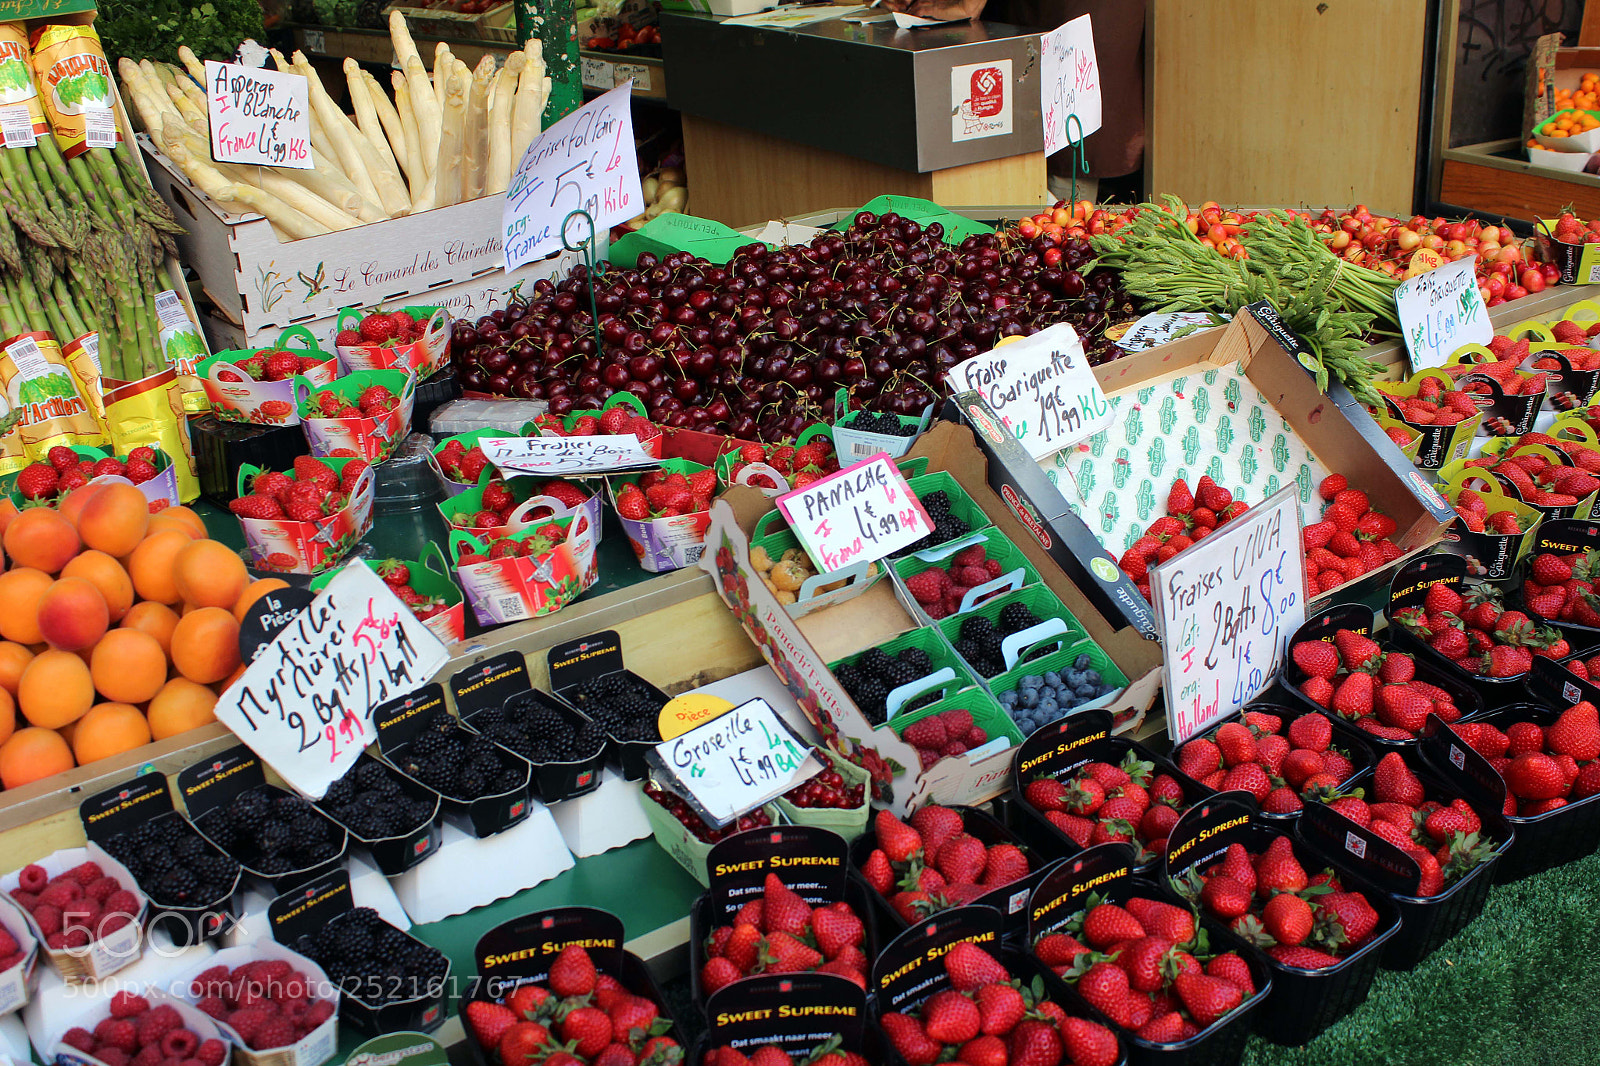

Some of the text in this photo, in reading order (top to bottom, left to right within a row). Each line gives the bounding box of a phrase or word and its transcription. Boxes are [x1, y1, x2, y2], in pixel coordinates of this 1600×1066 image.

[215, 65, 275, 108] Asperge
[243, 92, 301, 122] Blanche
[218, 122, 256, 157] France
[604, 176, 629, 217] Kilo
[505, 225, 550, 268] France
[1420, 252, 1438, 268] 1kg
[333, 236, 503, 294] Le Canard des Clairettes
[965, 359, 1007, 390] Fraise
[990, 350, 1075, 411] Gariguette
[31, 396, 88, 423] Artillero
[1423, 427, 1441, 468] Gariguette
[803, 464, 888, 521] PANACHE
[1003, 486, 1020, 510] PRINCE
[1023, 513, 1049, 547] BRETAGNE
[1488, 536, 1509, 578] Gariguette
[1540, 539, 1579, 552] SWEET
[1169, 565, 1223, 621] Fraises
[1232, 508, 1282, 581] VIVA
[266, 596, 282, 611] la
[1391, 586, 1415, 601] SWEET
[259, 607, 299, 632] Pièce
[552, 645, 617, 670] SWEET SUPREME
[457, 666, 522, 697] SWEET SUPREME
[379, 698, 442, 730] SWEET SUPREME
[1178, 678, 1219, 742] Holland
[288, 712, 321, 753] 2
[673, 713, 753, 768] Groseille
[1020, 730, 1106, 773] SWEET SUPREME
[186, 760, 255, 796] SWEET SUPREME
[88, 787, 163, 823] SWEET SUPREME
[1169, 815, 1250, 864] SWEET SUPREME
[715, 859, 765, 877] SWEET
[770, 855, 841, 868] SUPREME
[276, 883, 347, 925] SWEET SUPREME
[728, 888, 743, 898] Dat
[1033, 867, 1128, 922] SWEET SUPREME
[484, 947, 537, 969] SWEET
[881, 957, 922, 989] SWEET
[716, 1005, 857, 1027] SWEET SUPREME
[731, 1039, 748, 1049] Dat
[749, 1034, 784, 1046] smaakt
[784, 1033, 806, 1042] naar
